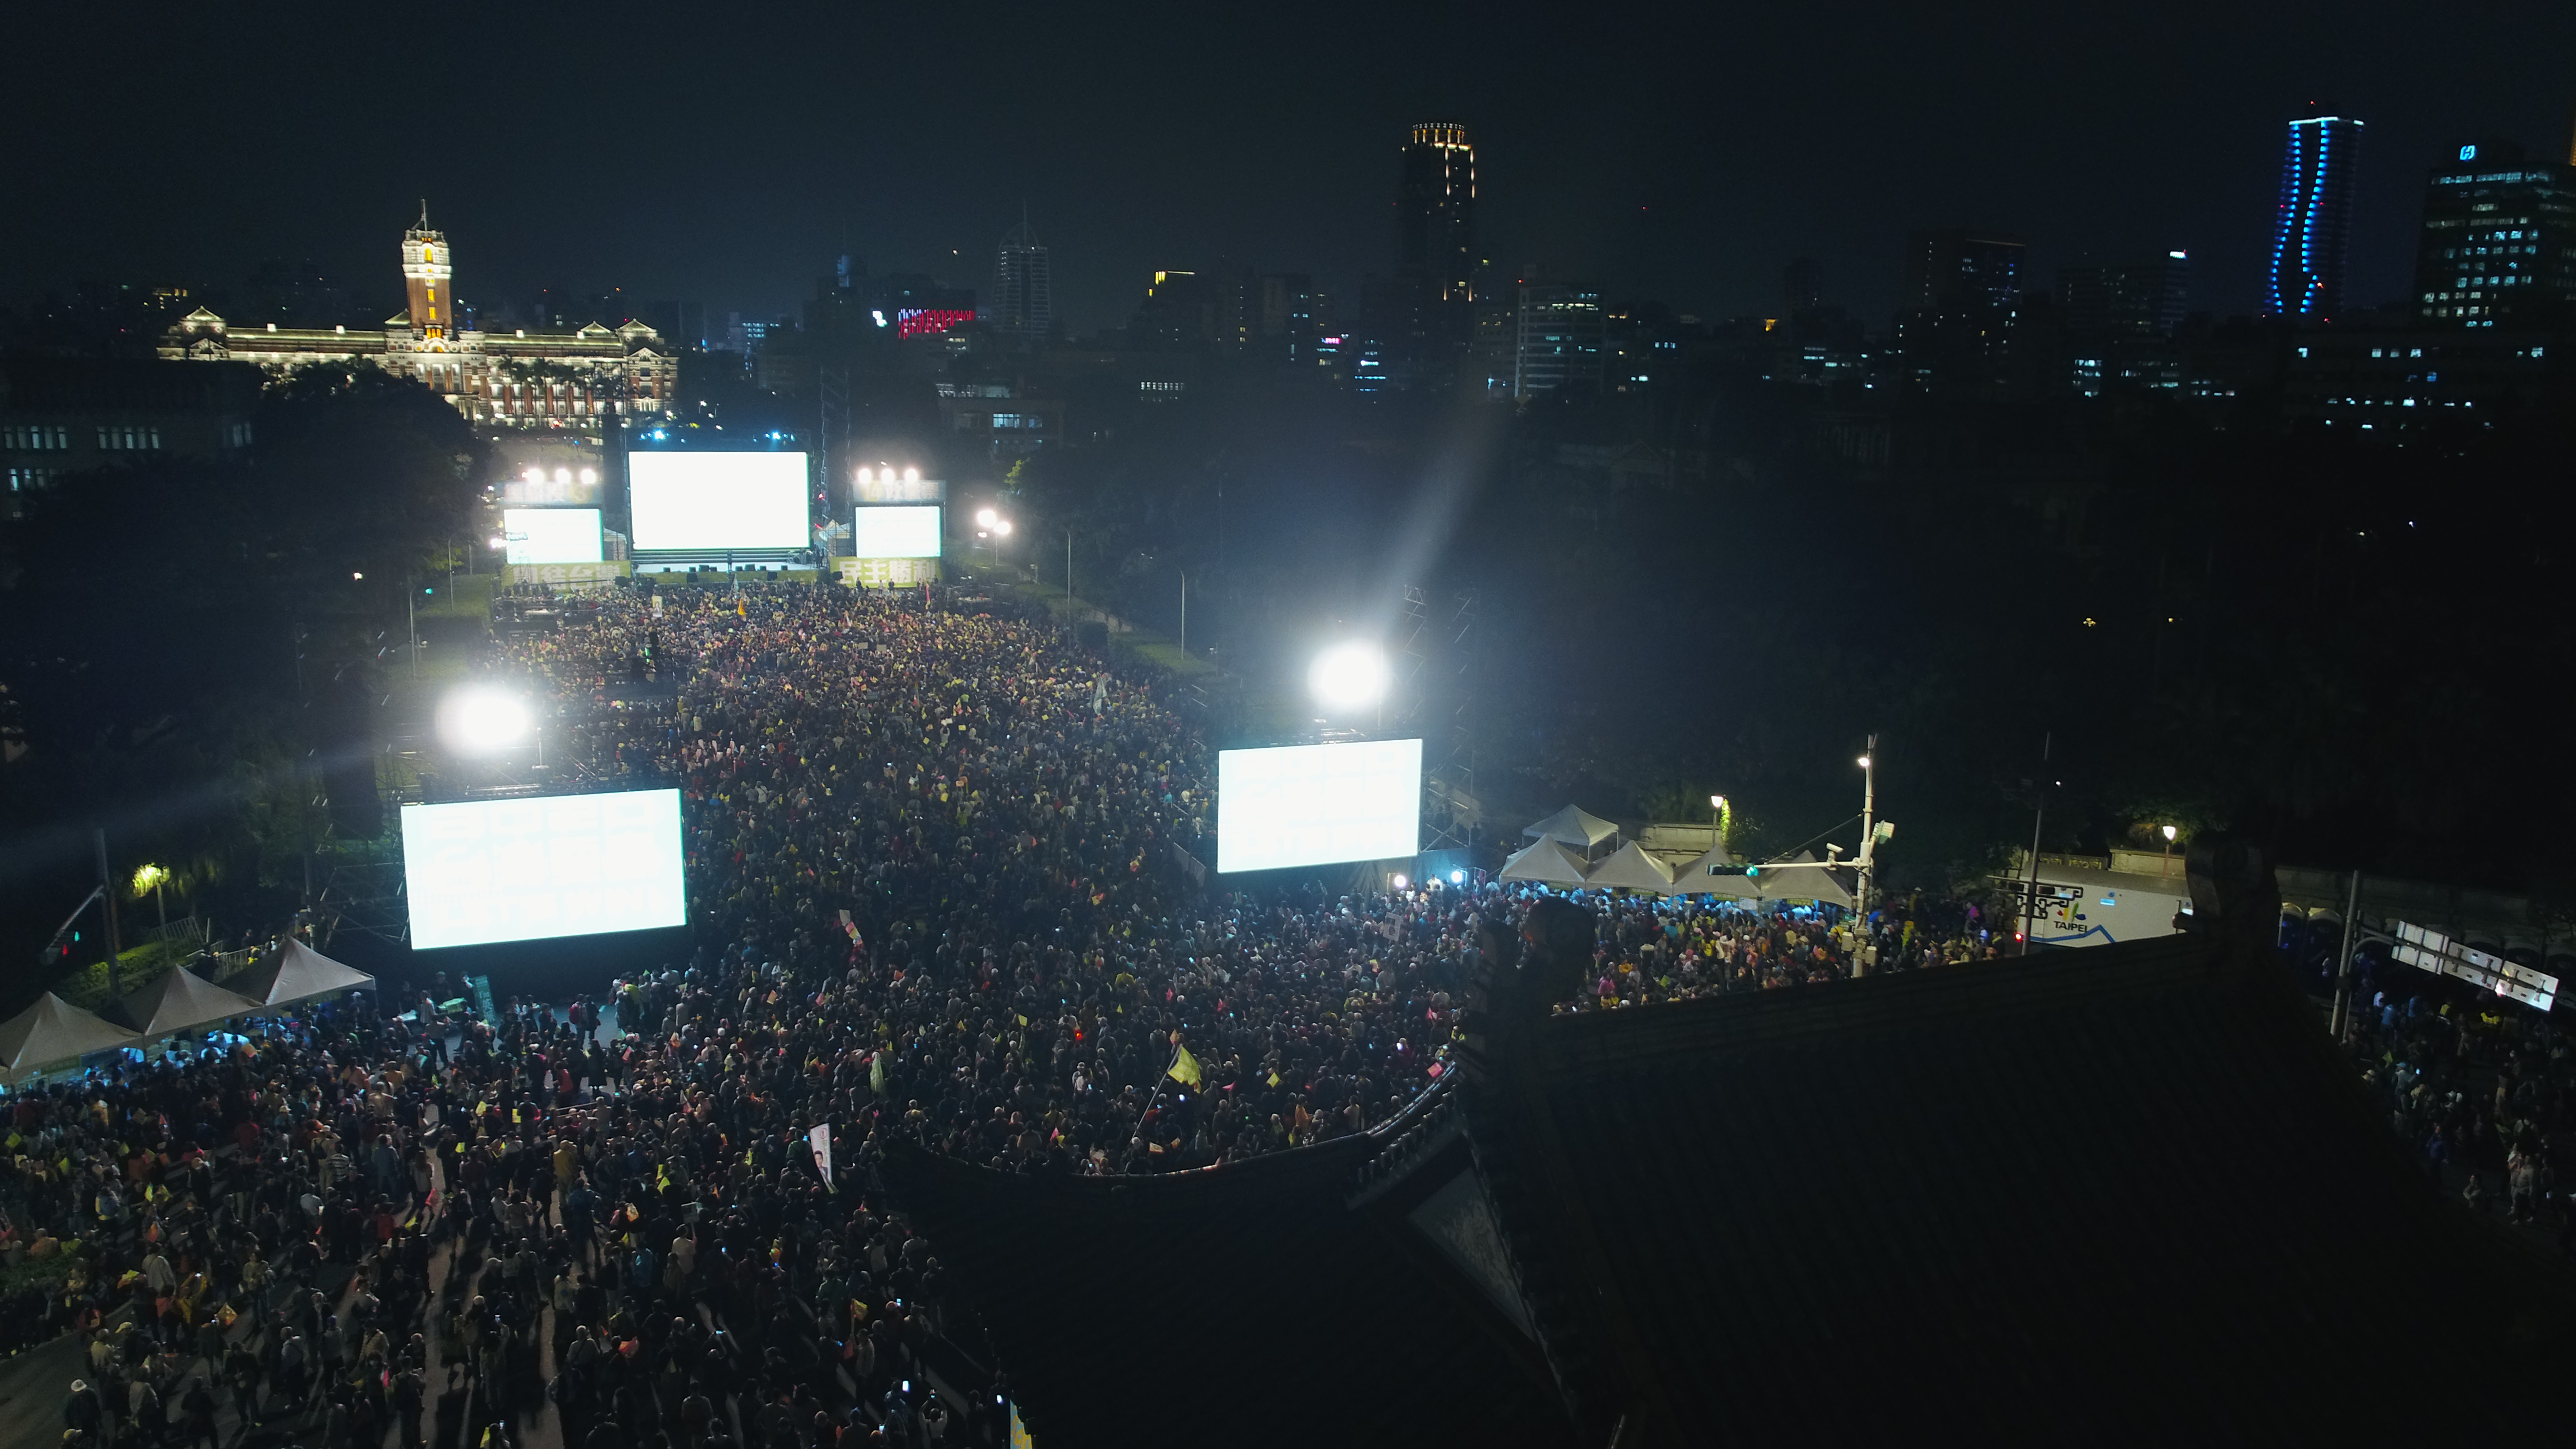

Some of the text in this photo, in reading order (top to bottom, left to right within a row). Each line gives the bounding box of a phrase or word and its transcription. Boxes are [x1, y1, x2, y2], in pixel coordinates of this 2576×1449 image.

[839, 560, 936, 584] 民主勝利
[2053, 921, 2088, 933] TAIPEI
